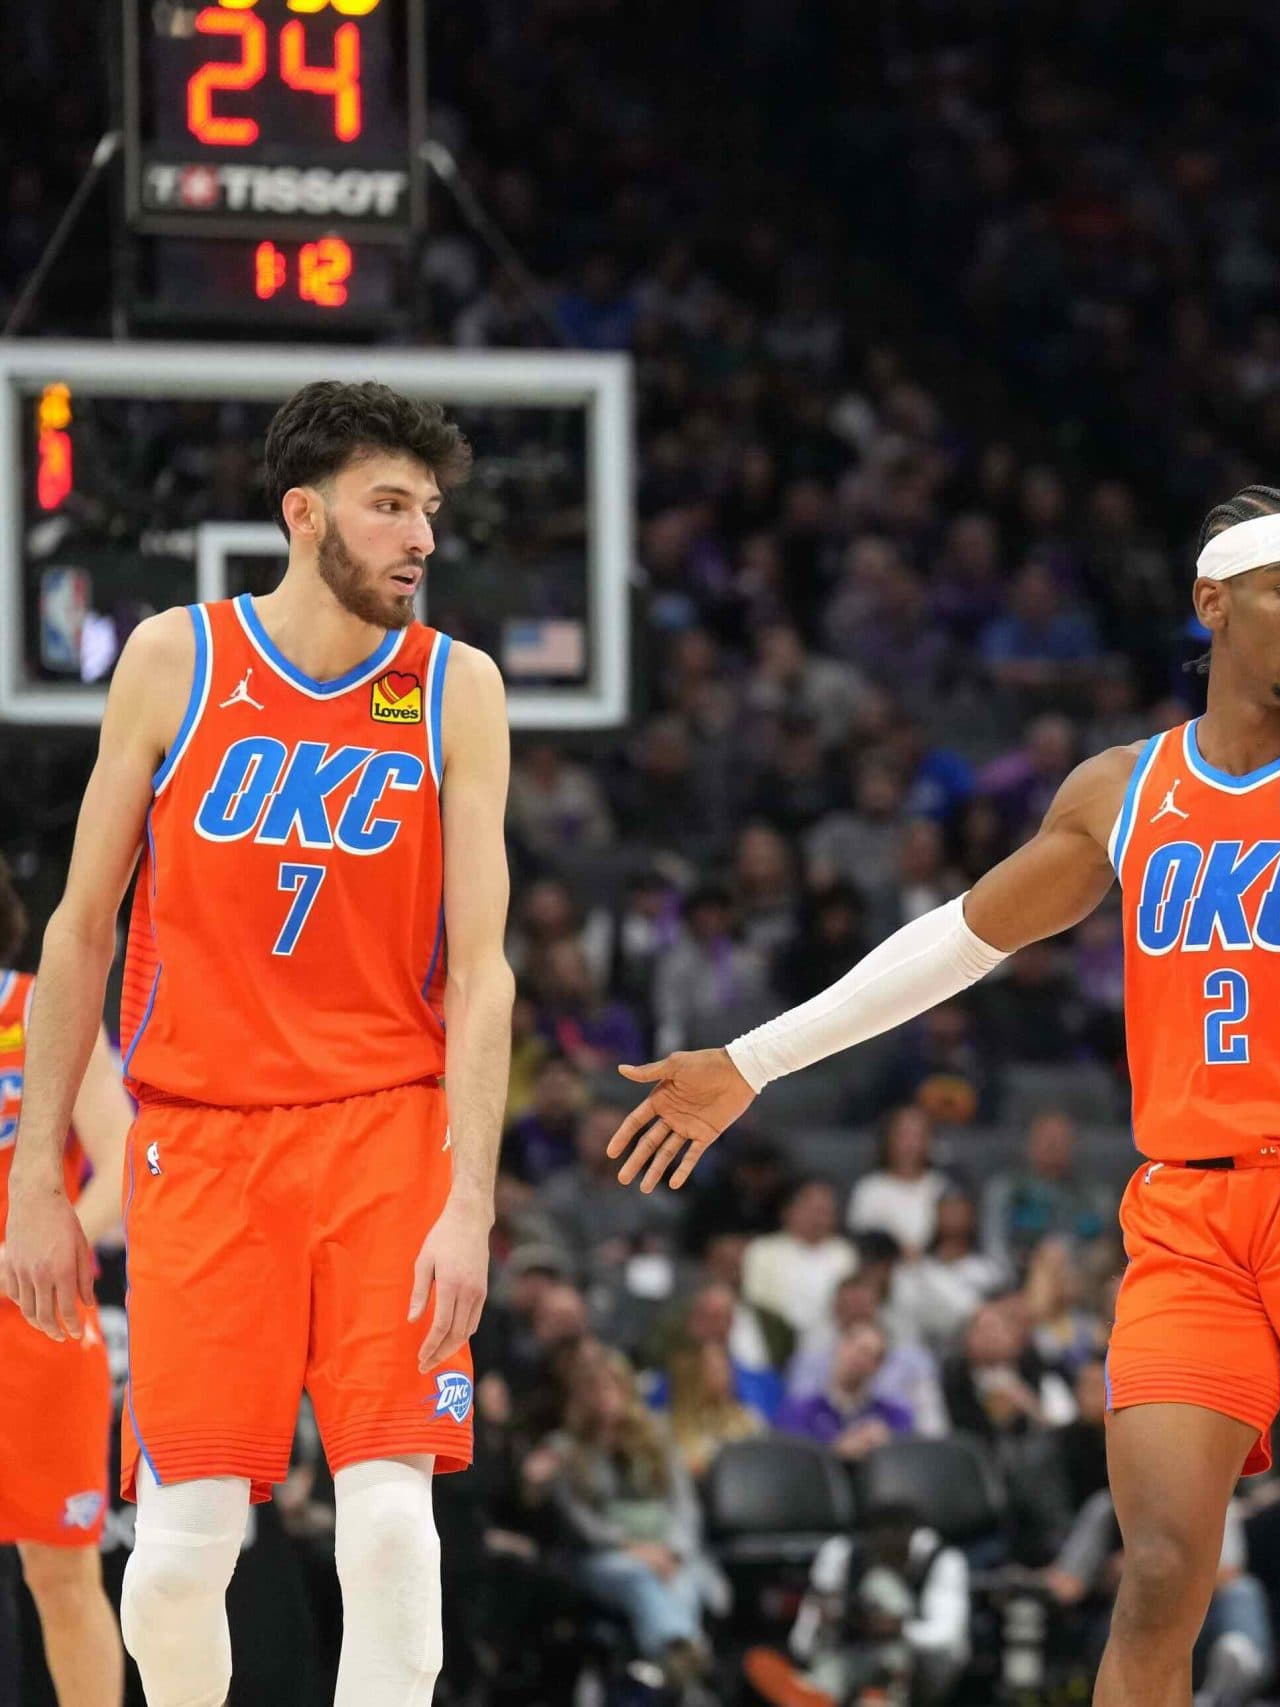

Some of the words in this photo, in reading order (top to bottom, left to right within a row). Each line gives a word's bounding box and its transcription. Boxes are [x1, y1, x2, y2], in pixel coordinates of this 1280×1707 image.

[186, 6, 362, 146] 24
[221, 164, 406, 216] TISSOT
[193, 735, 425, 856] OKC
[271, 862, 326, 956] 7
[1203, 968, 1250, 1065] 2
